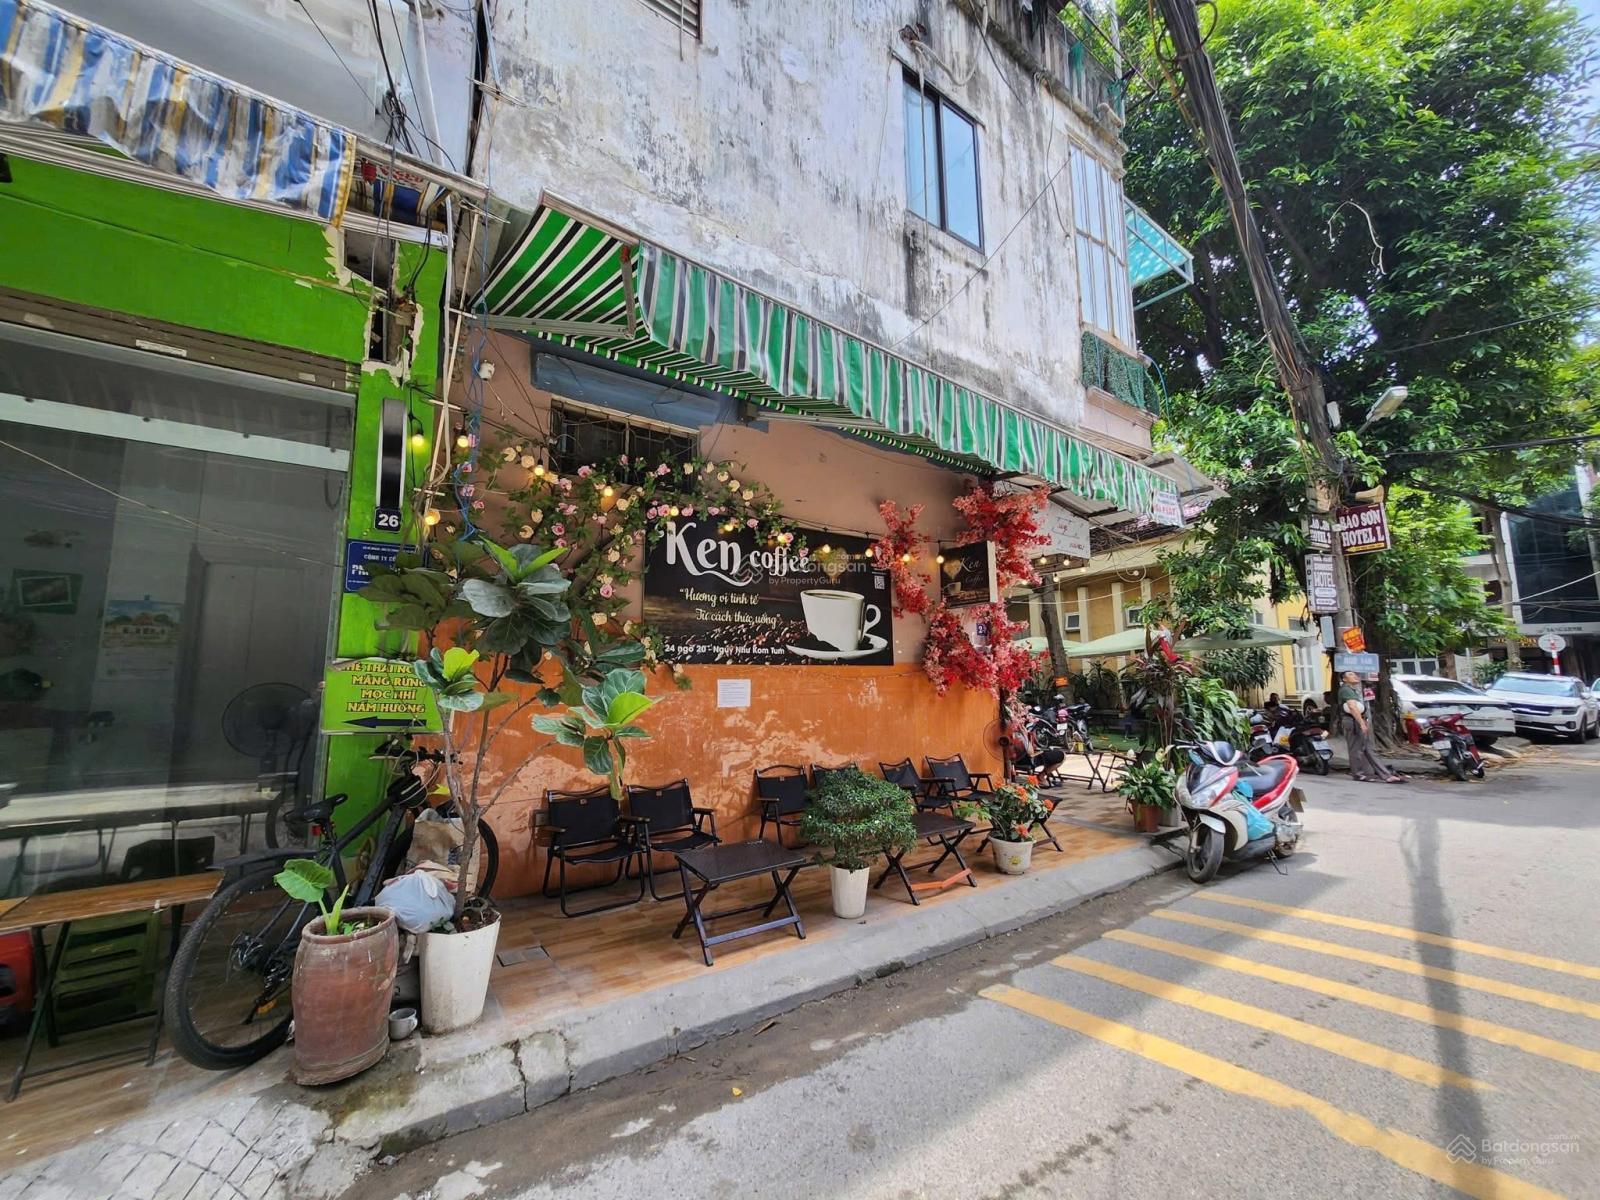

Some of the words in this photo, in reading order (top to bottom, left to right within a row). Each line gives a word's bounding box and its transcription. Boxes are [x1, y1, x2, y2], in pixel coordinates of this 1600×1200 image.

[378, 513, 399, 528] 26
[1342, 528, 1376, 547] HOTEL
[660, 521, 752, 586] Ken
[750, 545, 811, 577] coffee
[664, 643, 676, 653] 24
[696, 644, 707, 653] 20
